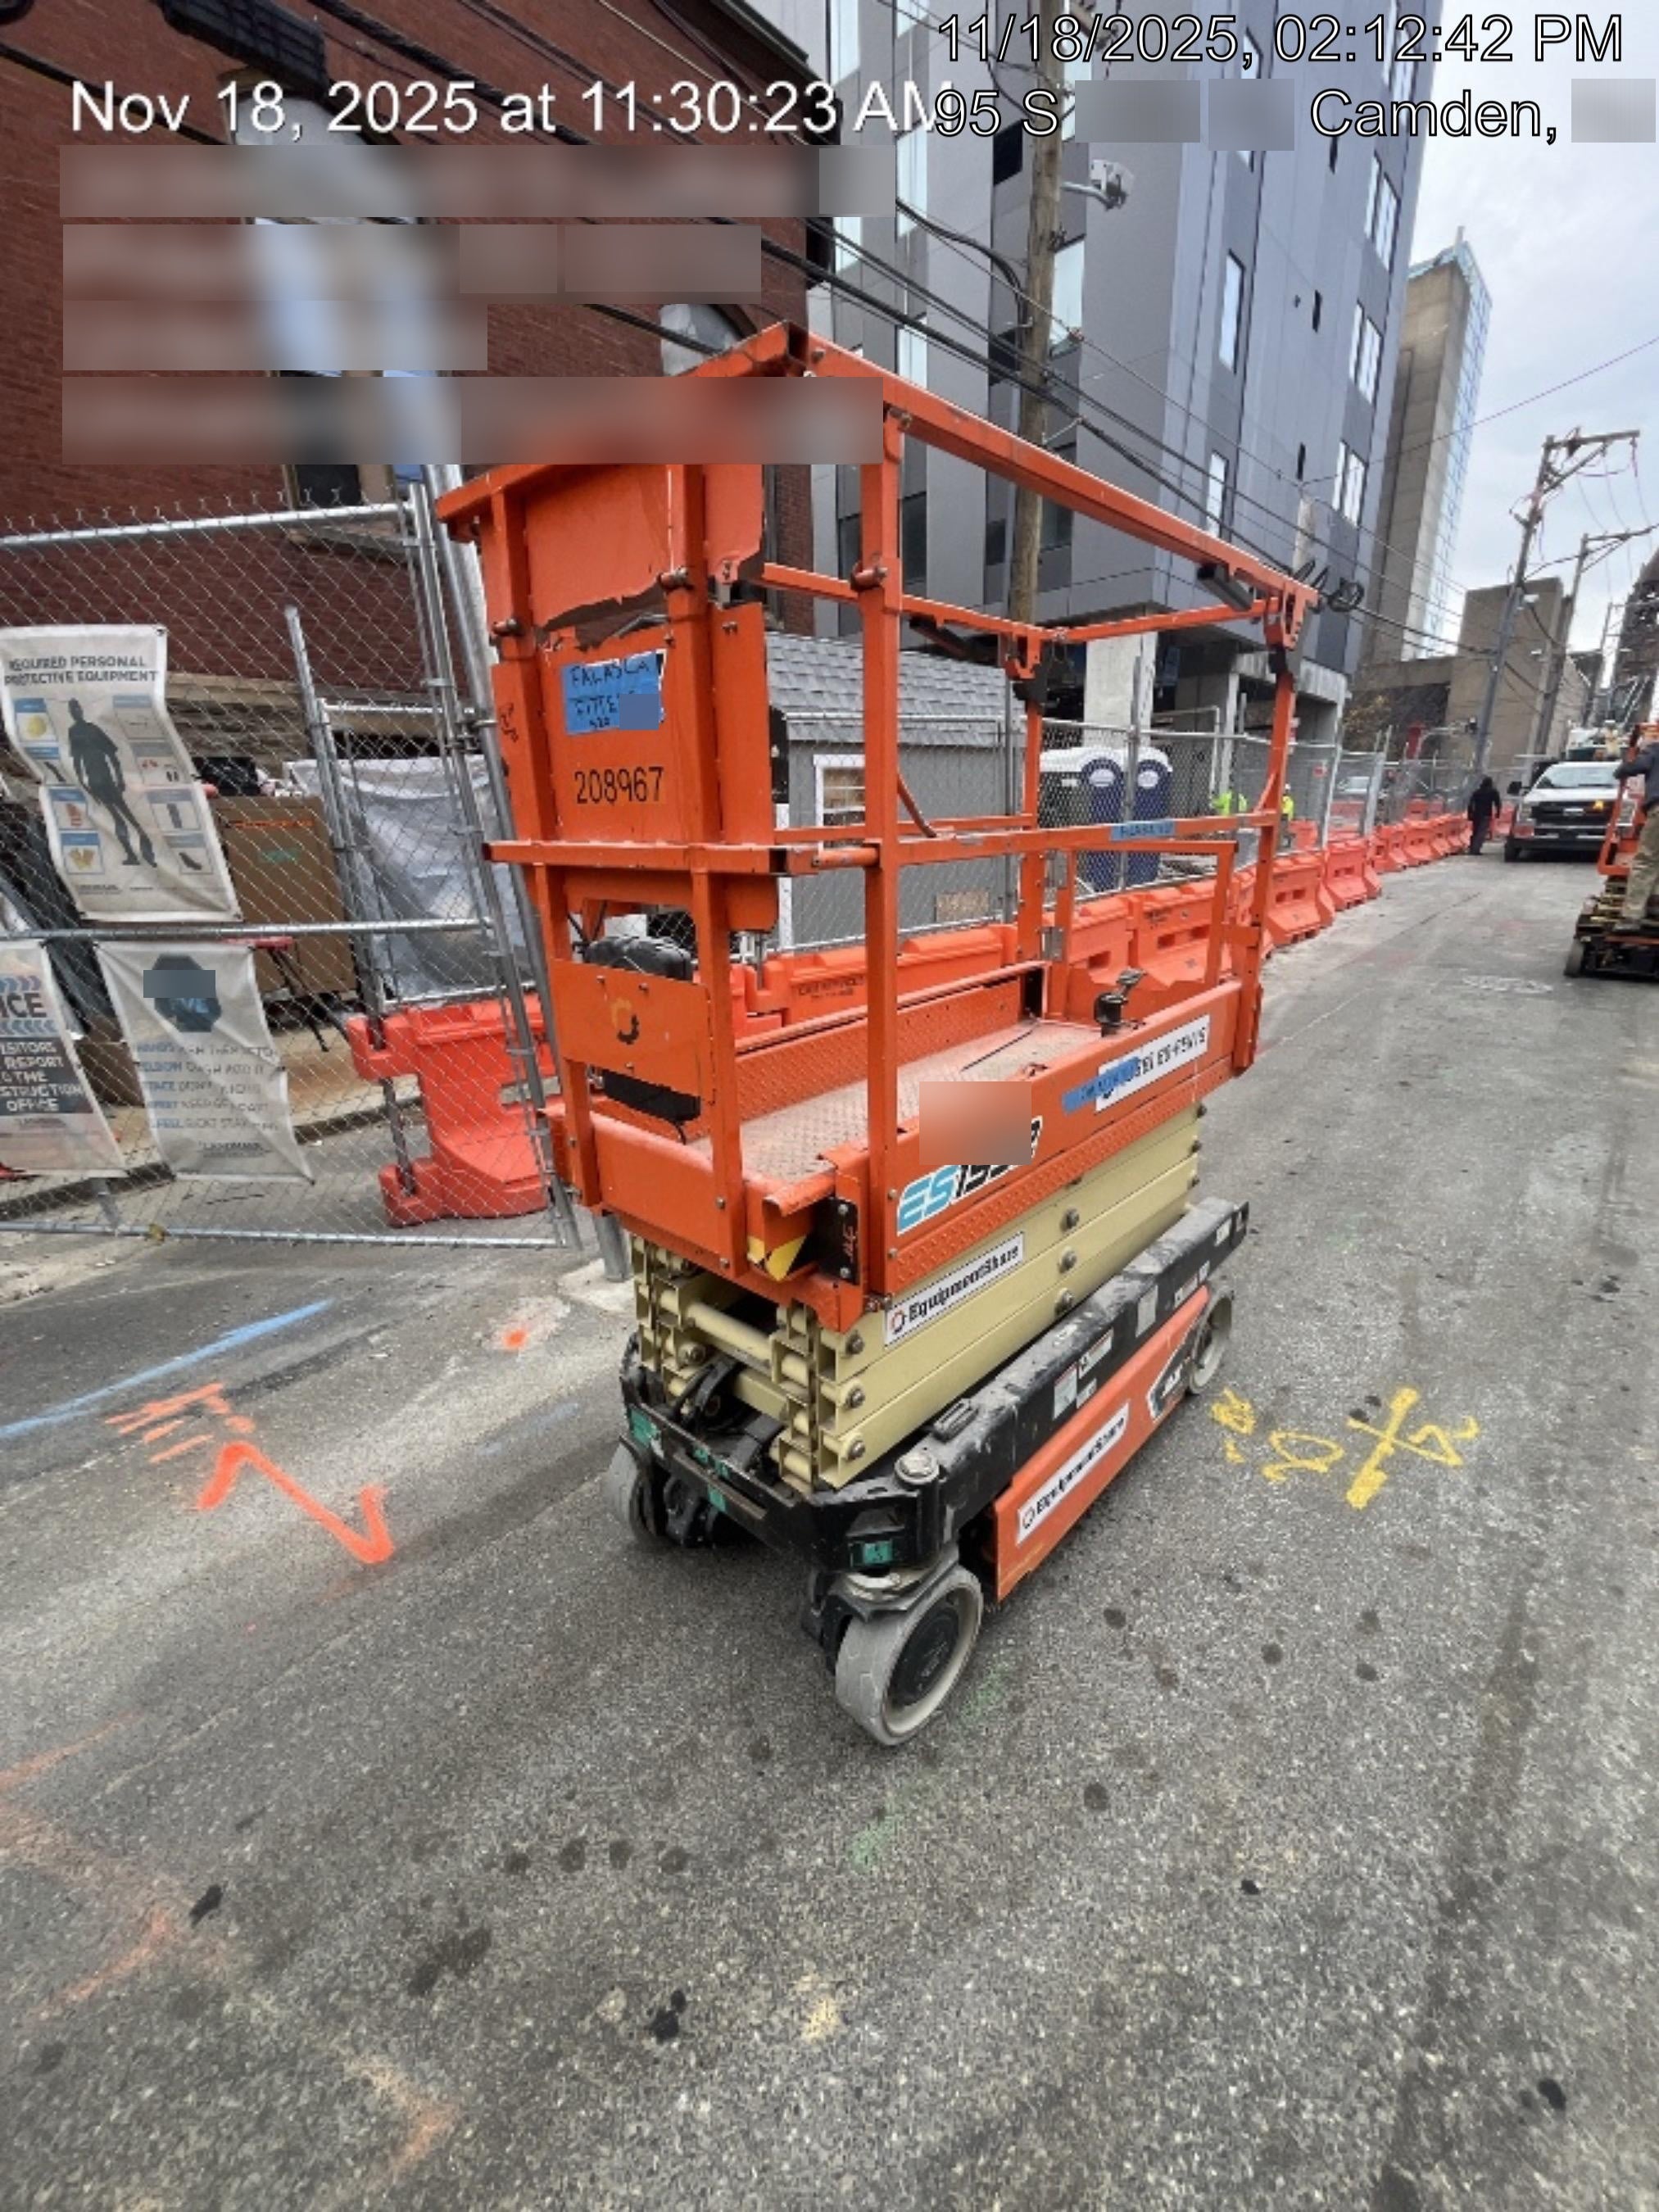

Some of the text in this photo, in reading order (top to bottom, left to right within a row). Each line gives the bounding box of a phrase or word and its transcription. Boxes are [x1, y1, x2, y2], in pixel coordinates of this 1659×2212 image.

[70, 655, 146, 669] PERSONAL
[77, 670, 158, 682] EQUIPMENT
[574, 766, 664, 805] 208967
